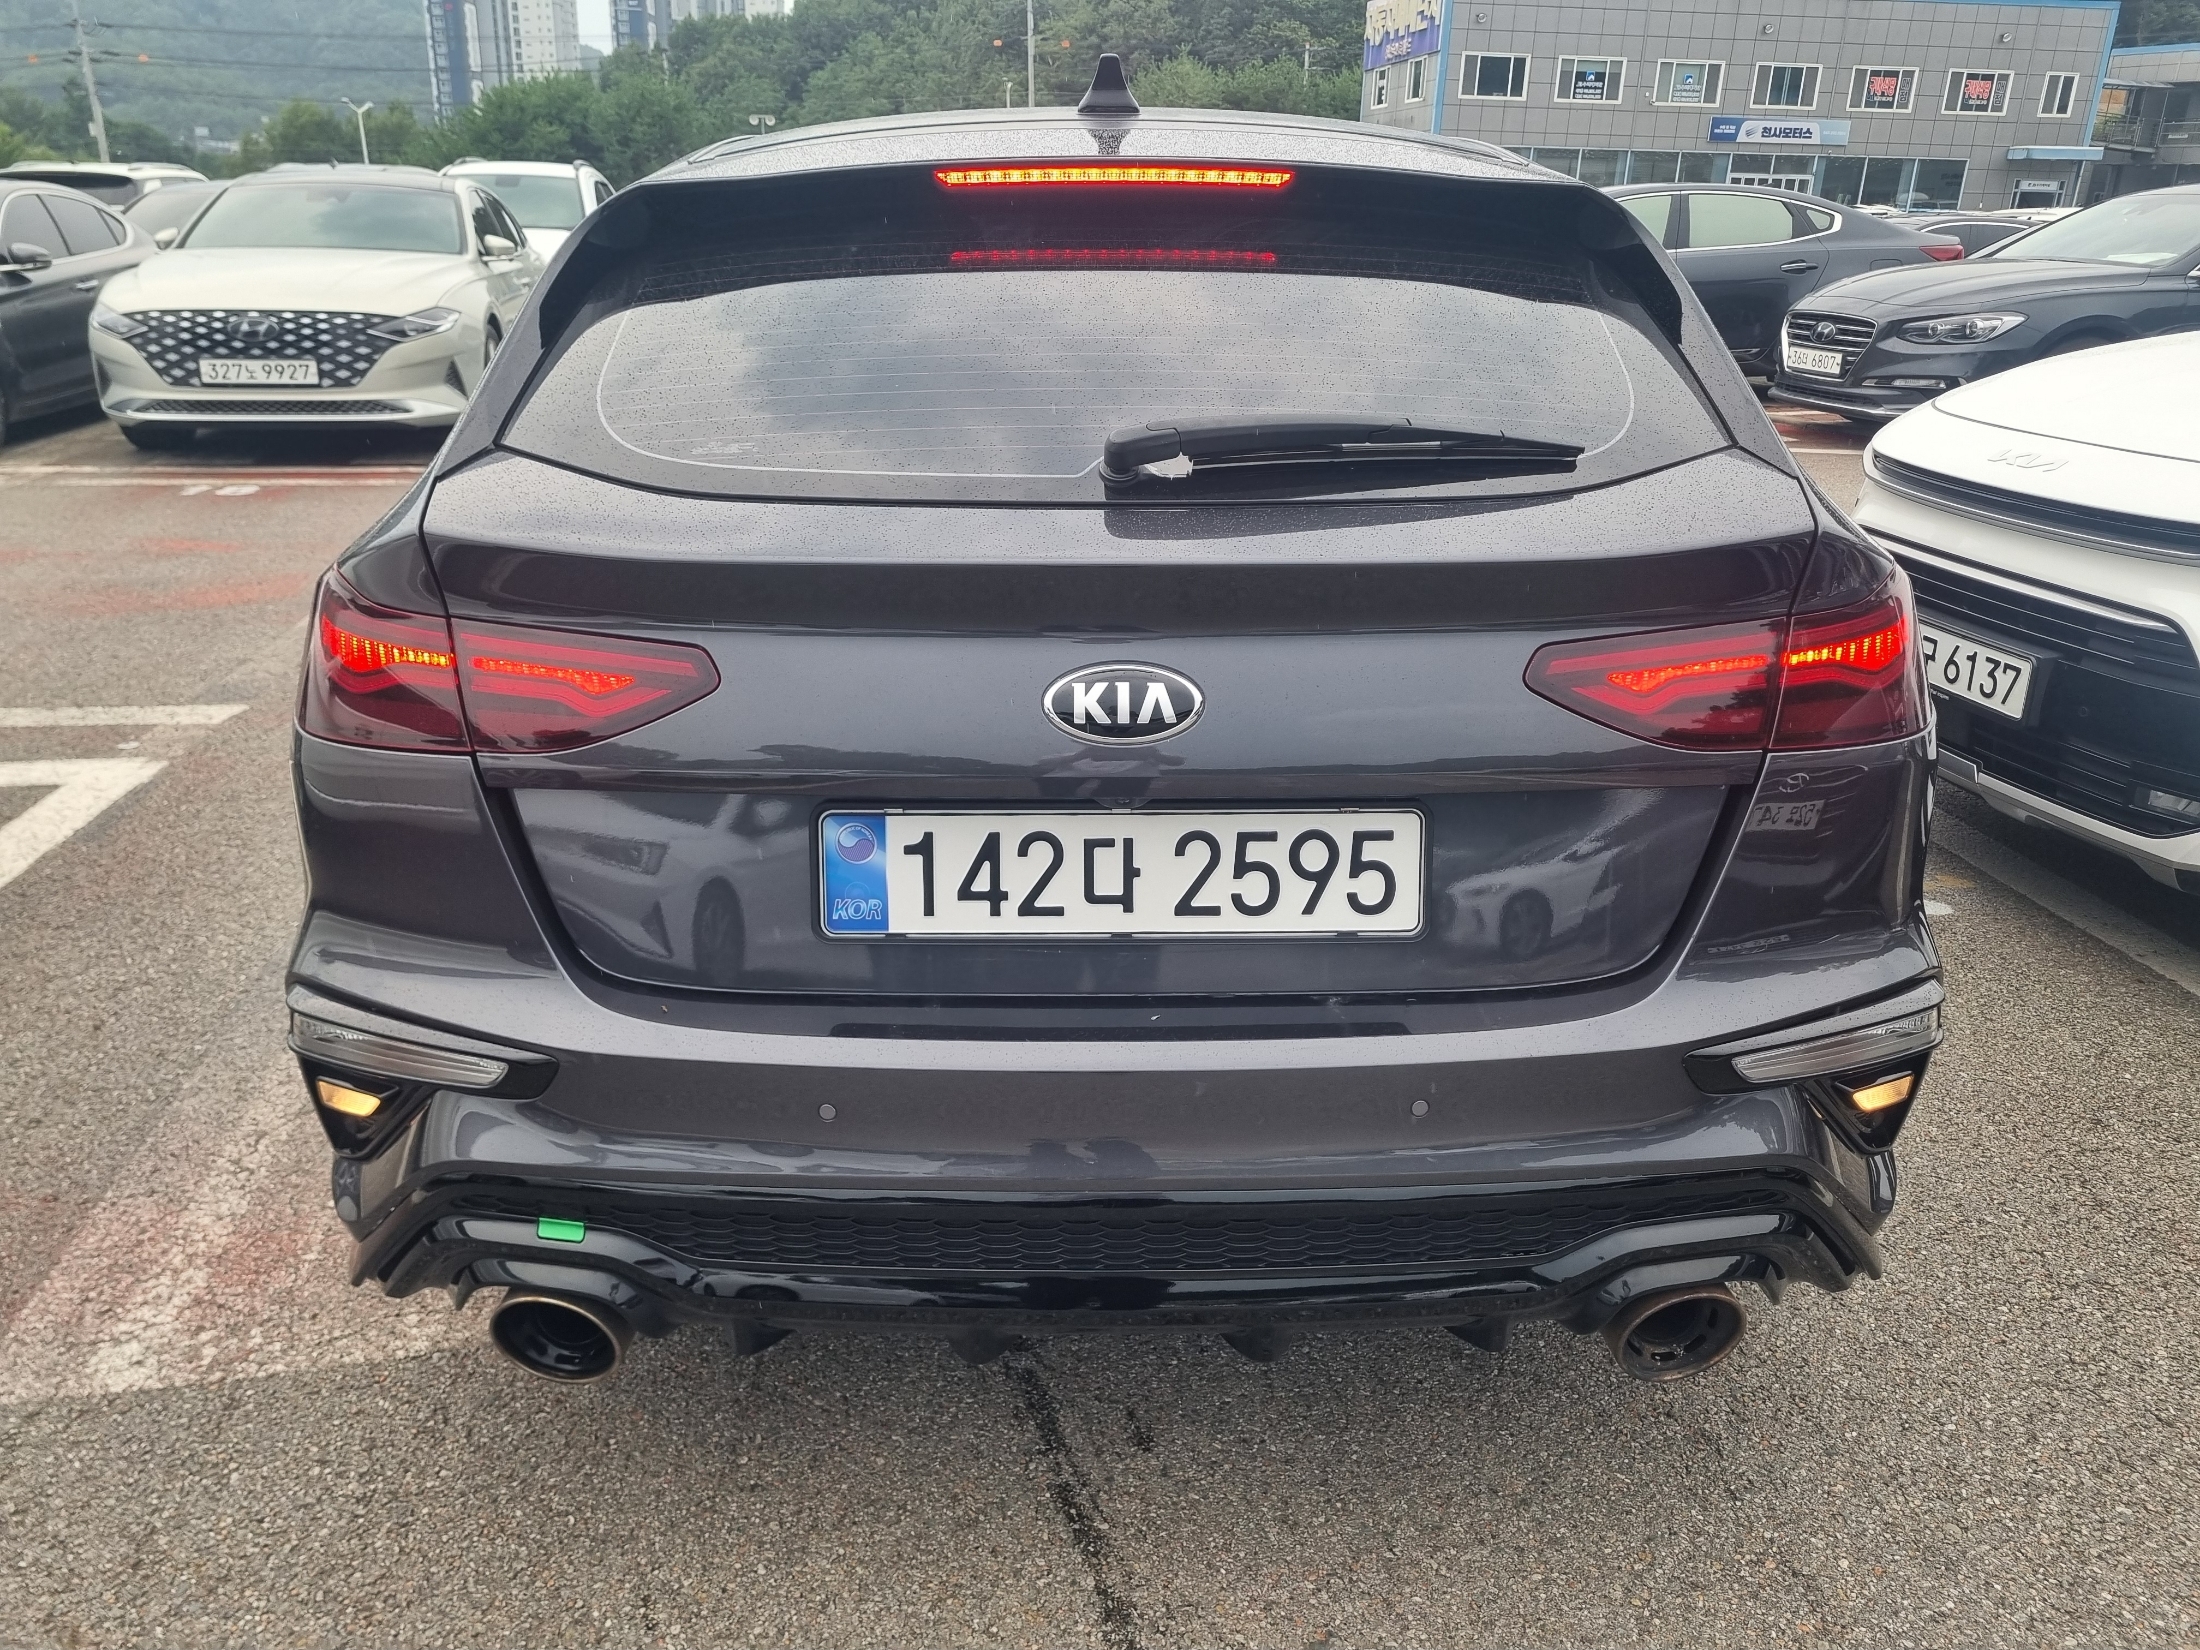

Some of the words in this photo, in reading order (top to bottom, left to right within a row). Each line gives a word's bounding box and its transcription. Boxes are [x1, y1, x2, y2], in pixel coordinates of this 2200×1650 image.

[261, 364, 309, 380] 9927
[1811, 353, 1836, 370] 6807
[1943, 644, 2022, 705] 6137
[1072, 682, 1177, 723] KIA
[903, 830, 1141, 918] 142다
[1173, 829, 1398, 917] 2595
[833, 899, 882, 920] KOR
